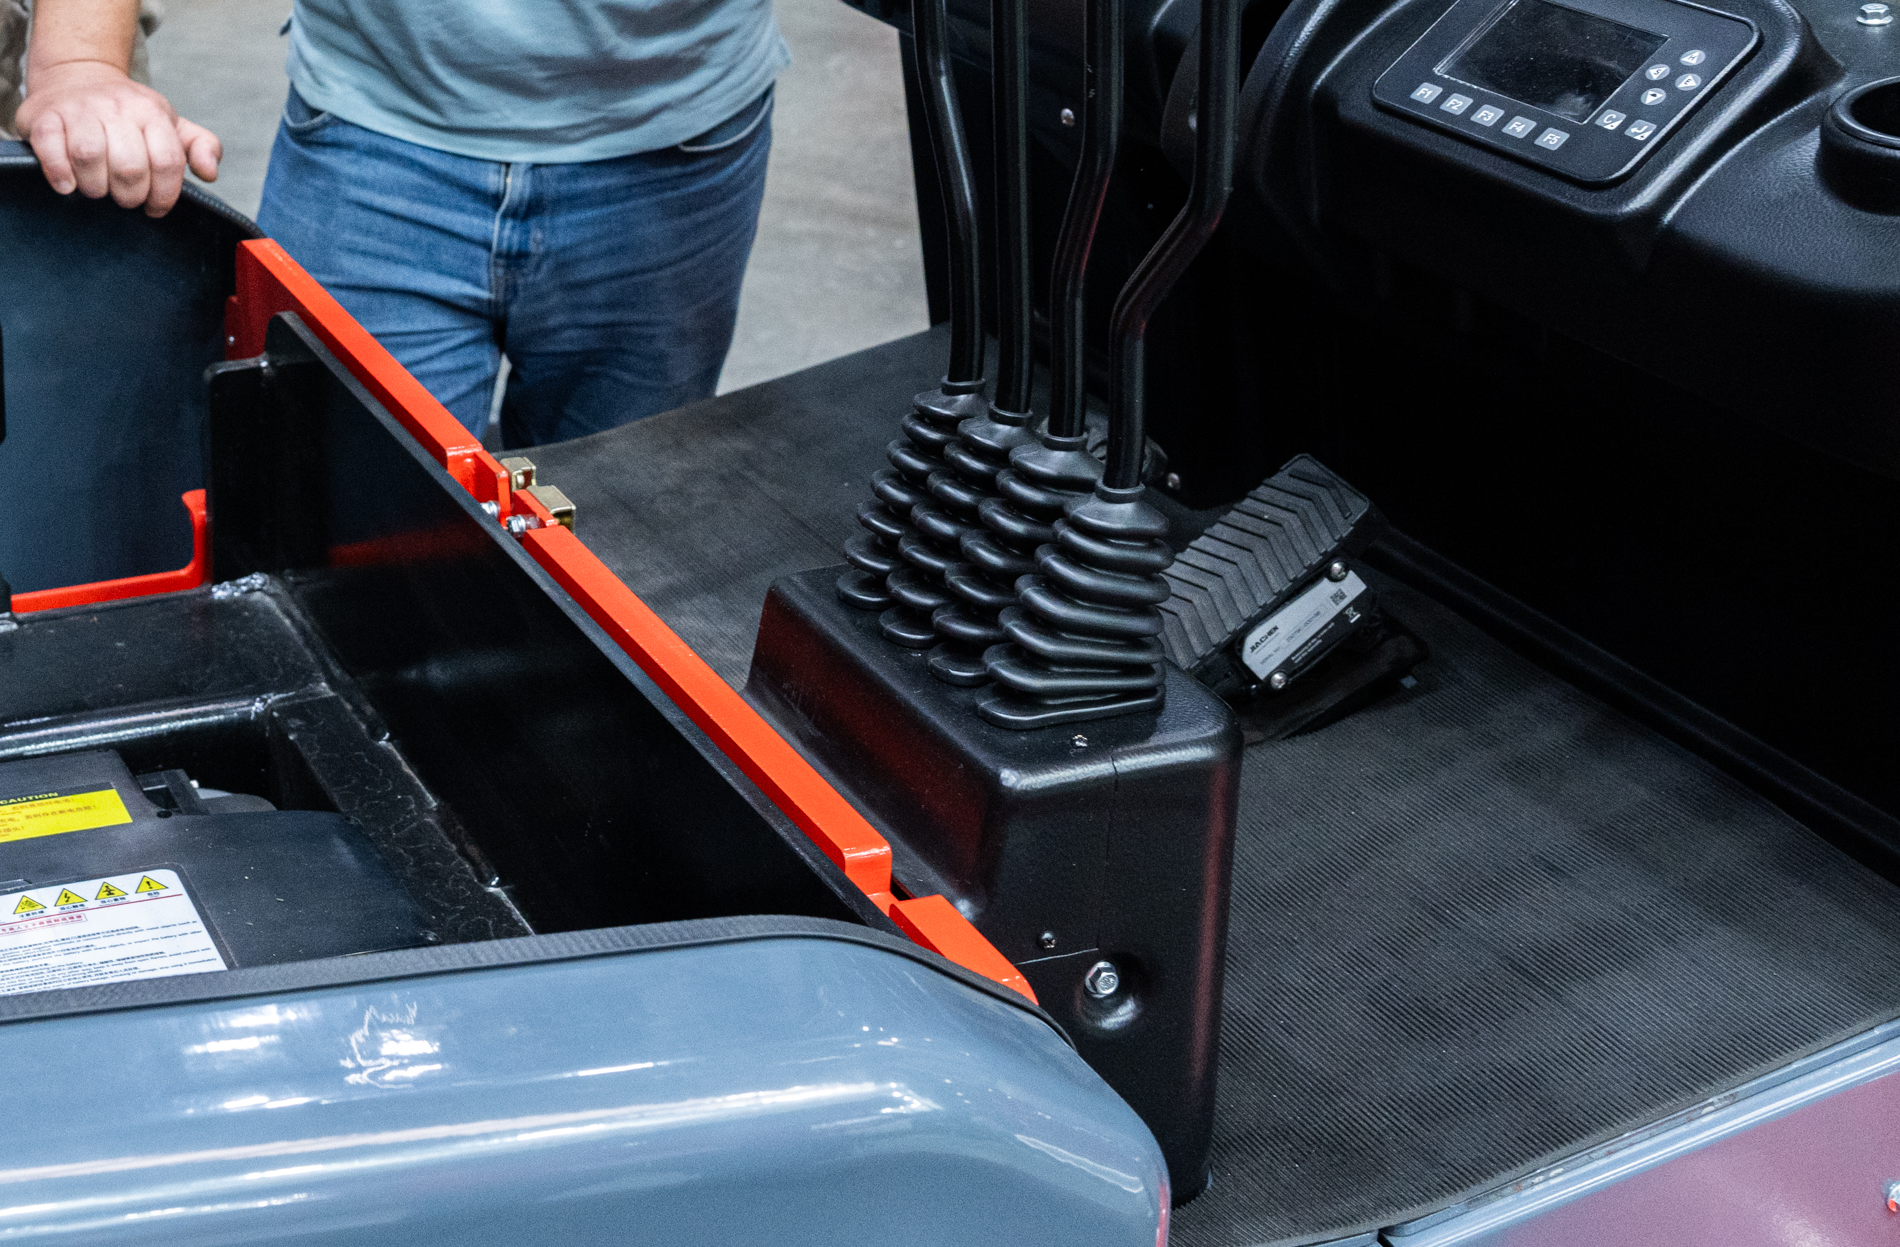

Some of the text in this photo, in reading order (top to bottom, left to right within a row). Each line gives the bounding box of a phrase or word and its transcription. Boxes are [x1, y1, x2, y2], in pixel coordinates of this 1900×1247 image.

[1417, 87, 1560, 145] F1 F2 F3 F4 F5
[0, 791, 59, 805] CAUTION
